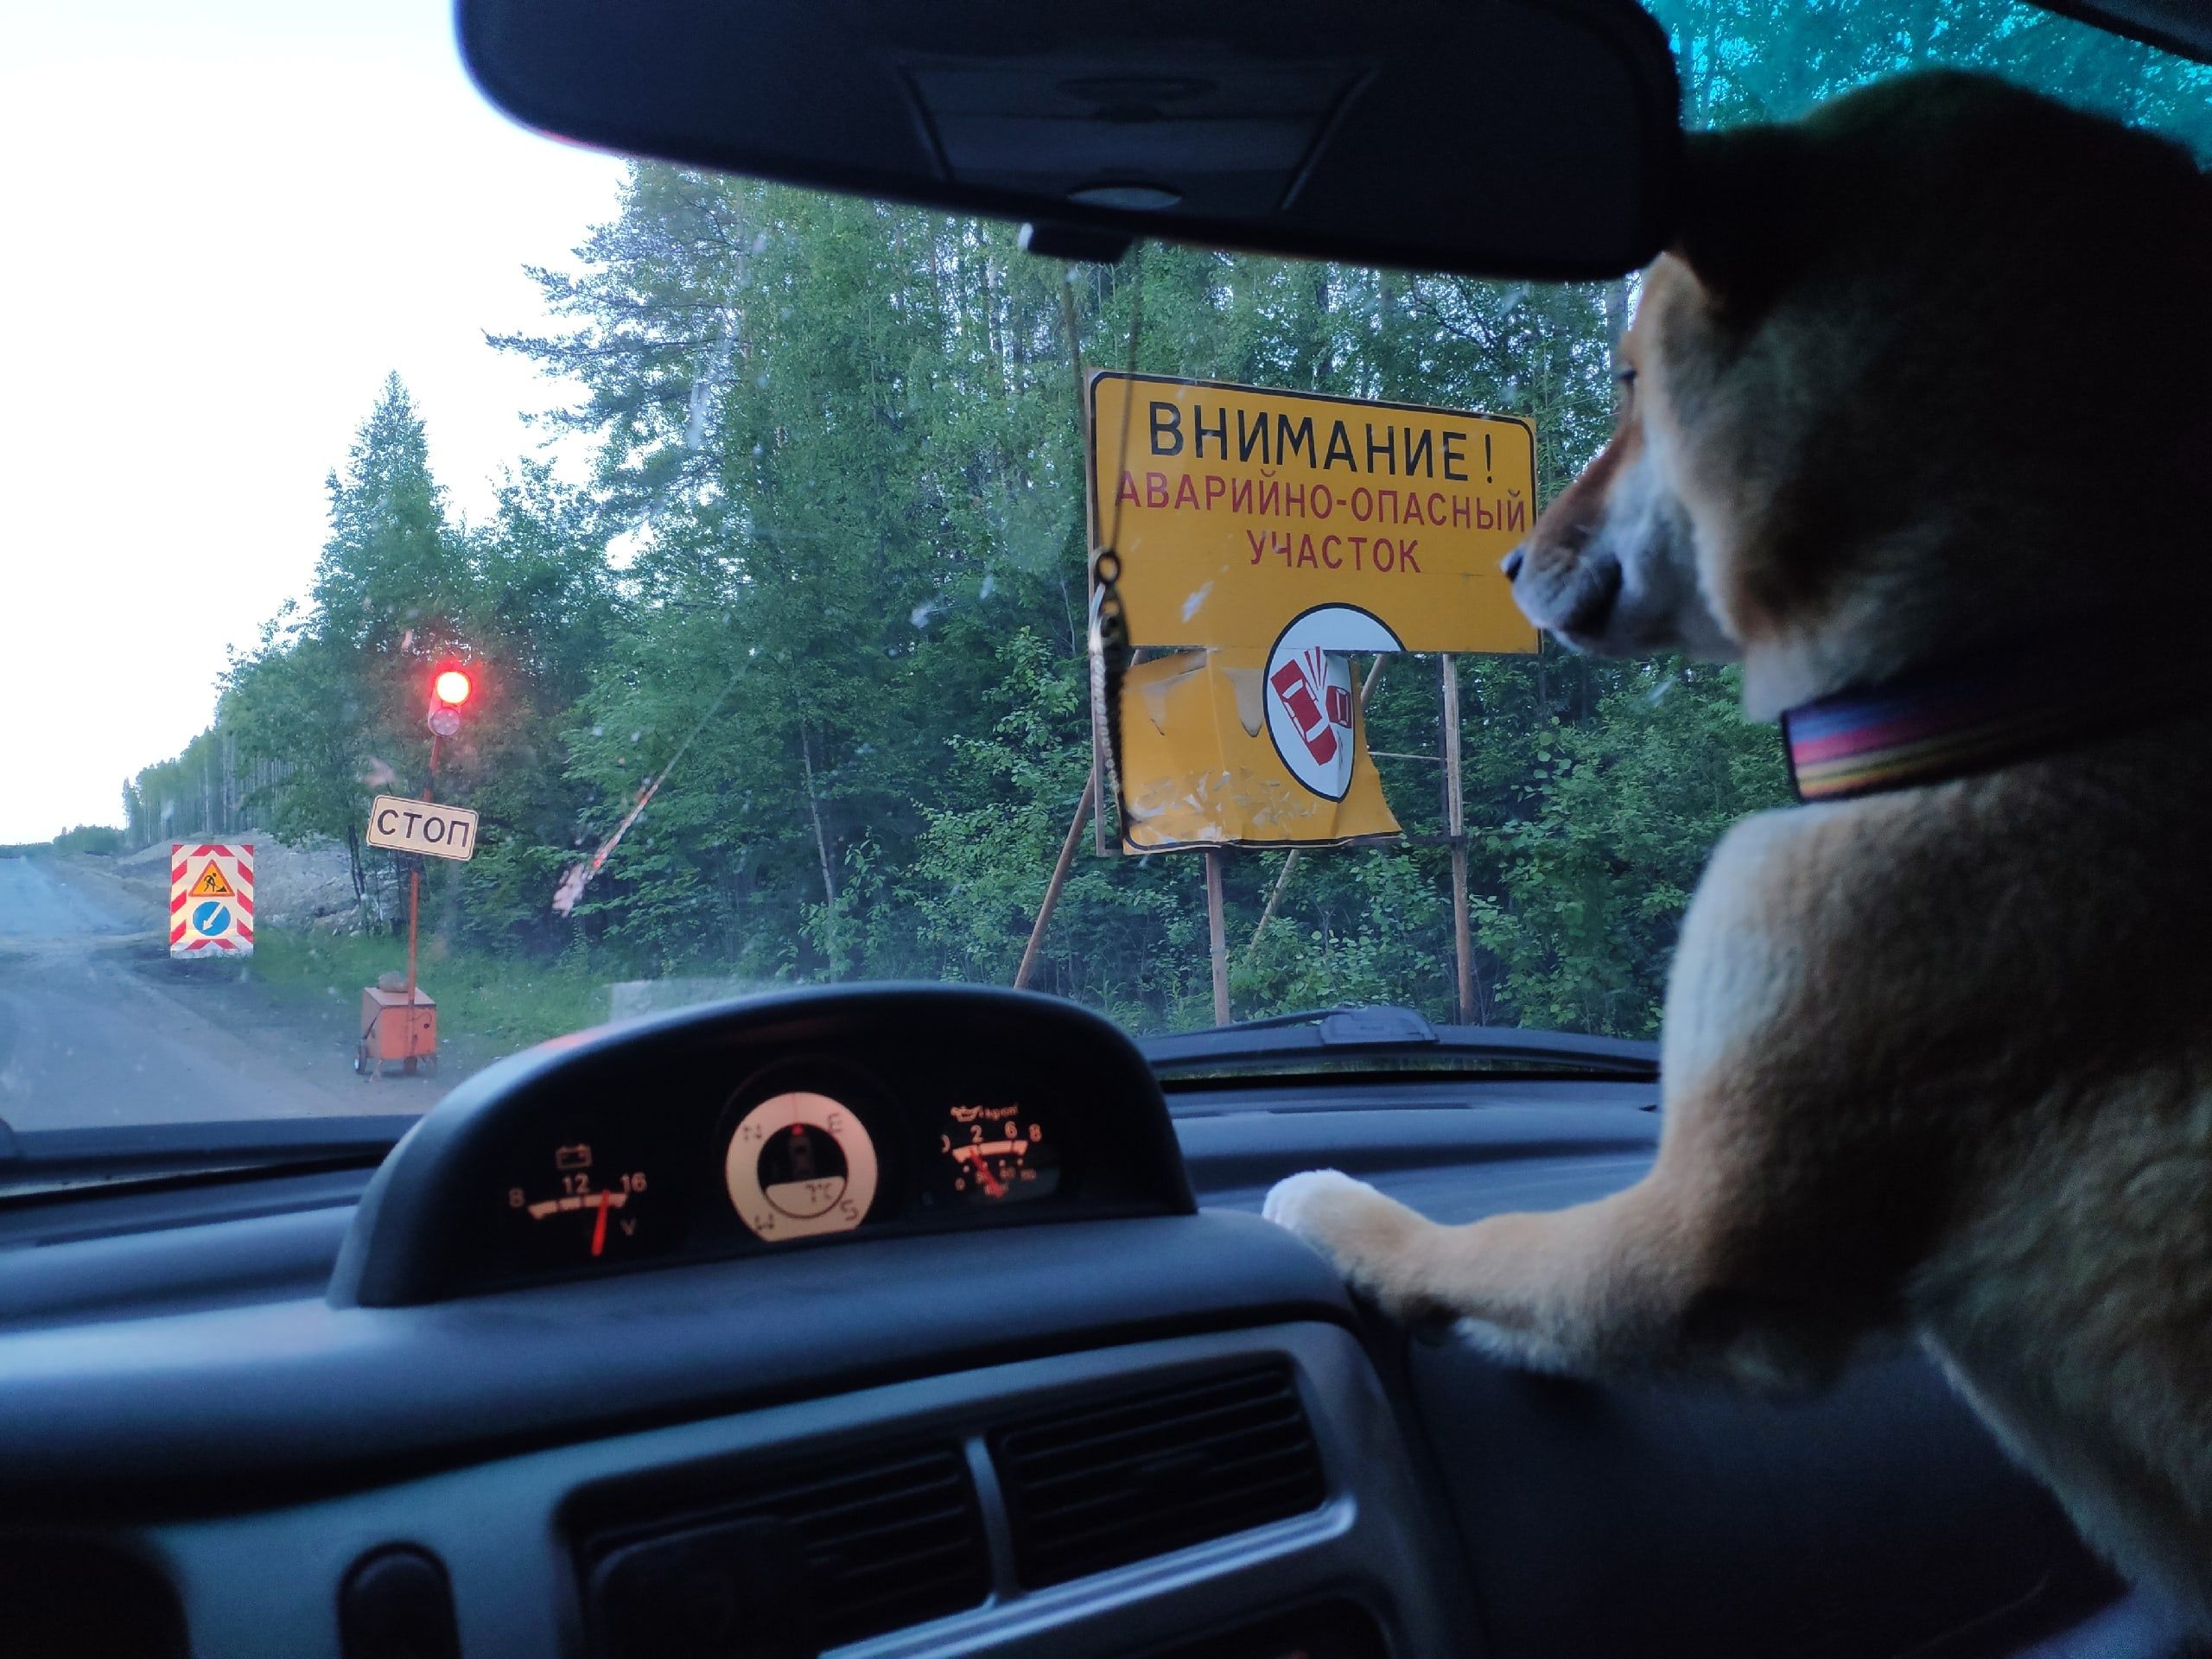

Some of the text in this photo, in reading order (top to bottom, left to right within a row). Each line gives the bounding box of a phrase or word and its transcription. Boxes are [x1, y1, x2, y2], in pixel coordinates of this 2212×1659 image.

[1116, 468, 1526, 533] АВАРИЙНО-ОПАСНЫЙ
[1247, 530, 1421, 573] УЧАСТОК
[377, 809, 469, 847] СТОП
[827, 1112, 843, 1134] E
[970, 1121, 1042, 1143] 2 6 8
[562, 1173, 589, 1194] 12
[840, 1199, 858, 1222] S
